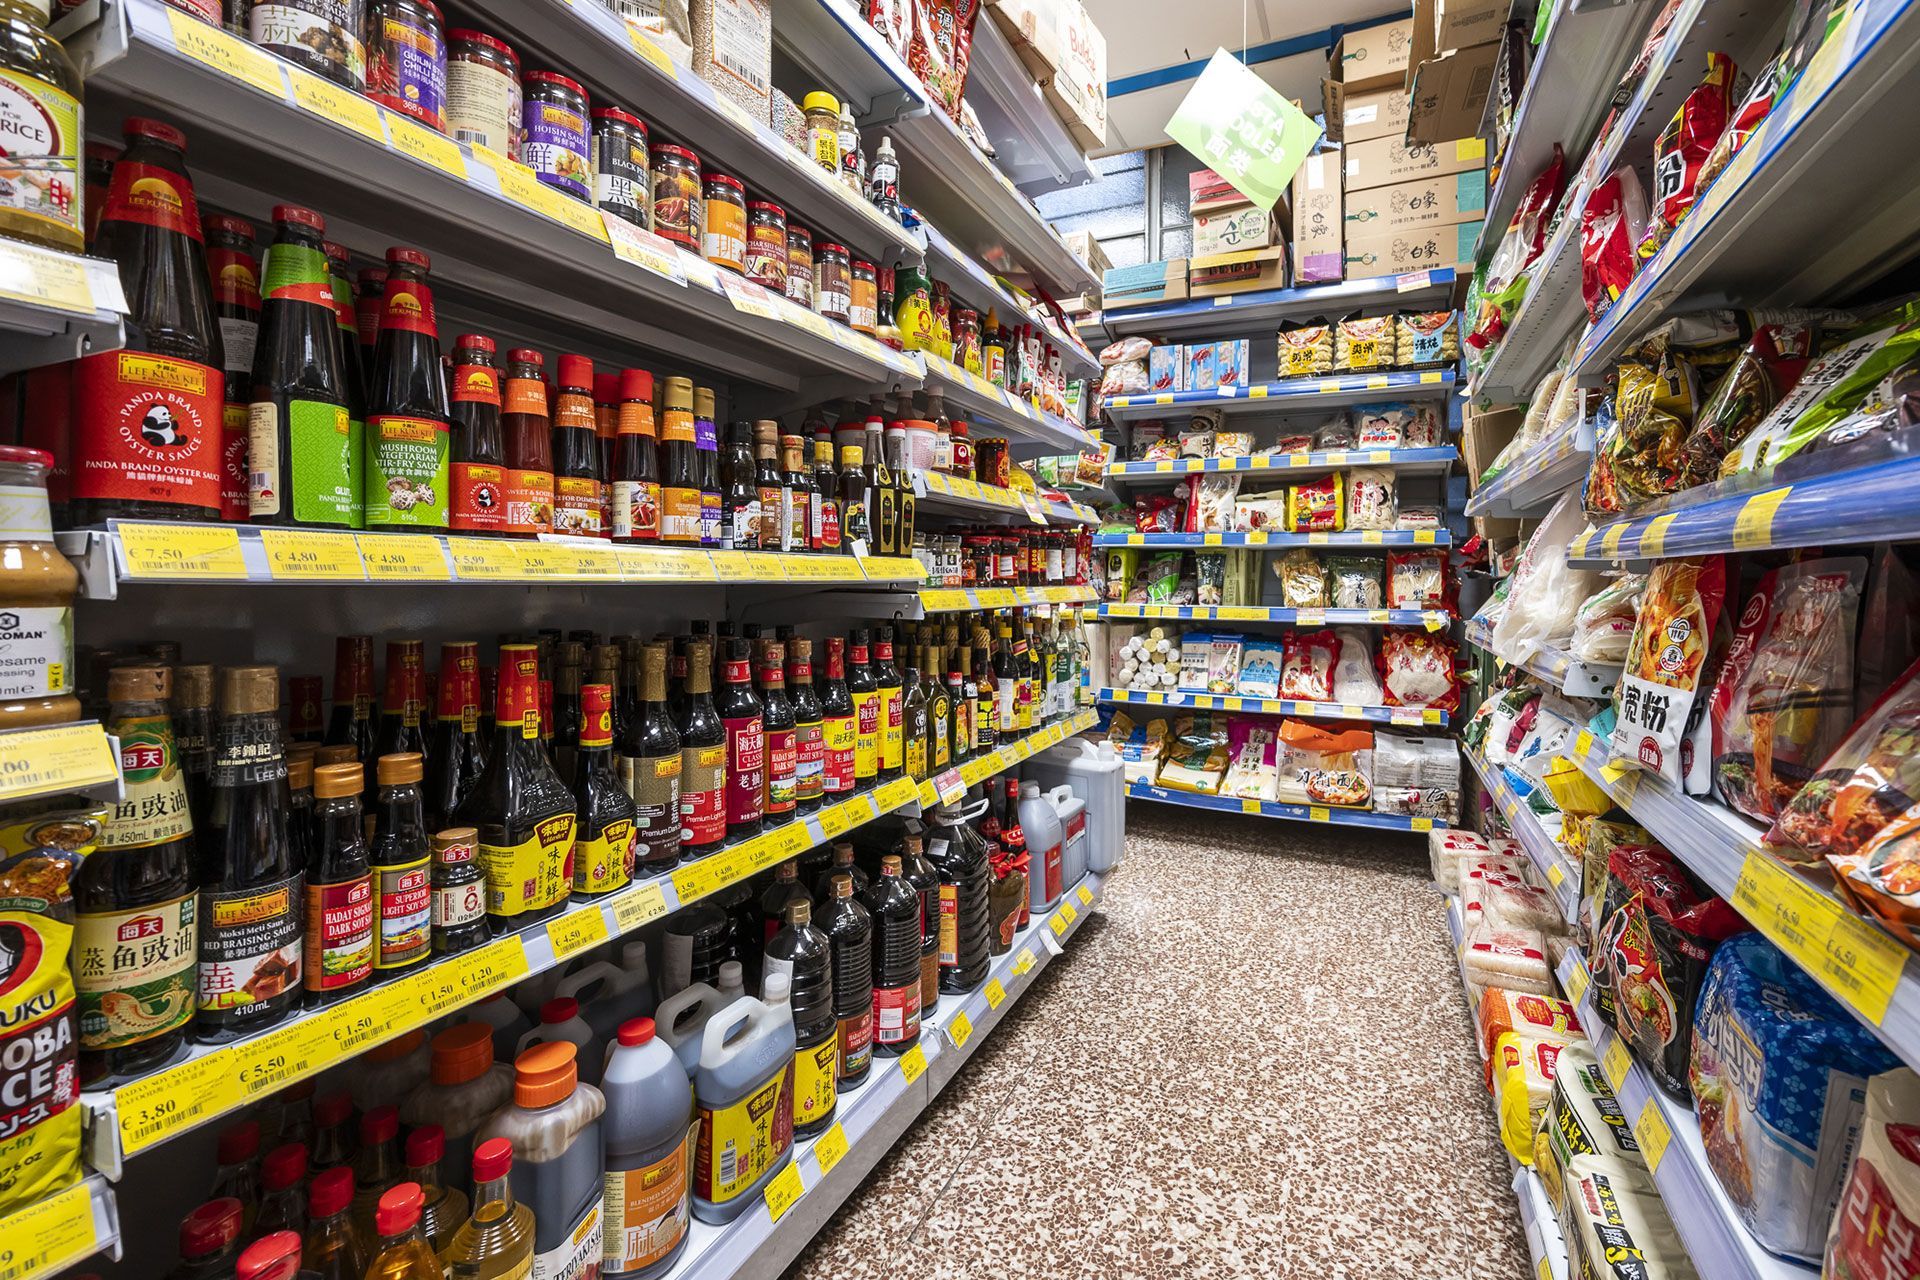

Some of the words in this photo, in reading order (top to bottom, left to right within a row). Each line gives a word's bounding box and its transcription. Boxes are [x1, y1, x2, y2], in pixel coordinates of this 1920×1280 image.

[403, 50, 431, 68] GUILIN
[403, 60, 430, 77] CHILLI
[535, 124, 567, 138] HOISIN
[612, 158, 635, 171] BLACK
[608, 176, 634, 207] 黑
[128, 366, 147, 376] LEE
[152, 370, 180, 383] KUM
[183, 376, 200, 386] KEE
[120, 391, 163, 417] PANDA
[168, 393, 203, 428] BRAND
[120, 426, 165, 462] OYSTER
[169, 437, 202, 462] SAUCE
[381, 444, 437, 455] MUSHROOM
[375, 459, 415, 469] STIR-FRY
[379, 452, 438, 462] VEGETARIAN
[86, 460, 118, 470] PANDA
[121, 461, 162, 474] BRAND
[164, 465, 201, 478] OYSTER
[129, 550, 139, 559] €
[1297, 770, 1350, 787] 刀削面
[686, 815, 710, 823] Premium
[642, 827, 667, 837] Premium
[546, 846, 560, 901] 味极鲜
[396, 888, 426, 904] SUPERIOR
[221, 910, 237, 919] LEE
[240, 902, 266, 917] KUM
[384, 905, 404, 916] LIGHT
[406, 901, 419, 912] SOY
[325, 910, 351, 925] HADAY
[121, 920, 163, 940] 海天
[204, 940, 220, 950] RED
[223, 932, 272, 949] BRAISING
[273, 921, 297, 938] SAUCE
[219, 929, 244, 939] Moksi
[246, 926, 265, 935] Meti
[267, 919, 285, 929] Saus
[328, 923, 351, 937] DARK
[352, 917, 364, 930] SOY
[82, 928, 192, 977] 蒸鱼豉油
[461, 975, 469, 986] €
[471, 966, 492, 982] 1,20
[421, 994, 428, 1005] €
[431, 985, 453, 1000] 1,50
[235, 1004, 253, 1016] 410
[255, 1001, 271, 1010] mL
[334, 1029, 342, 1040] €
[347, 1017, 372, 1034] 1,50
[240, 1070, 249, 1082] €
[254, 1055, 286, 1074] 5,50
[122, 1116, 132, 1130] €
[630, 1193, 658, 1207] BLENDED
